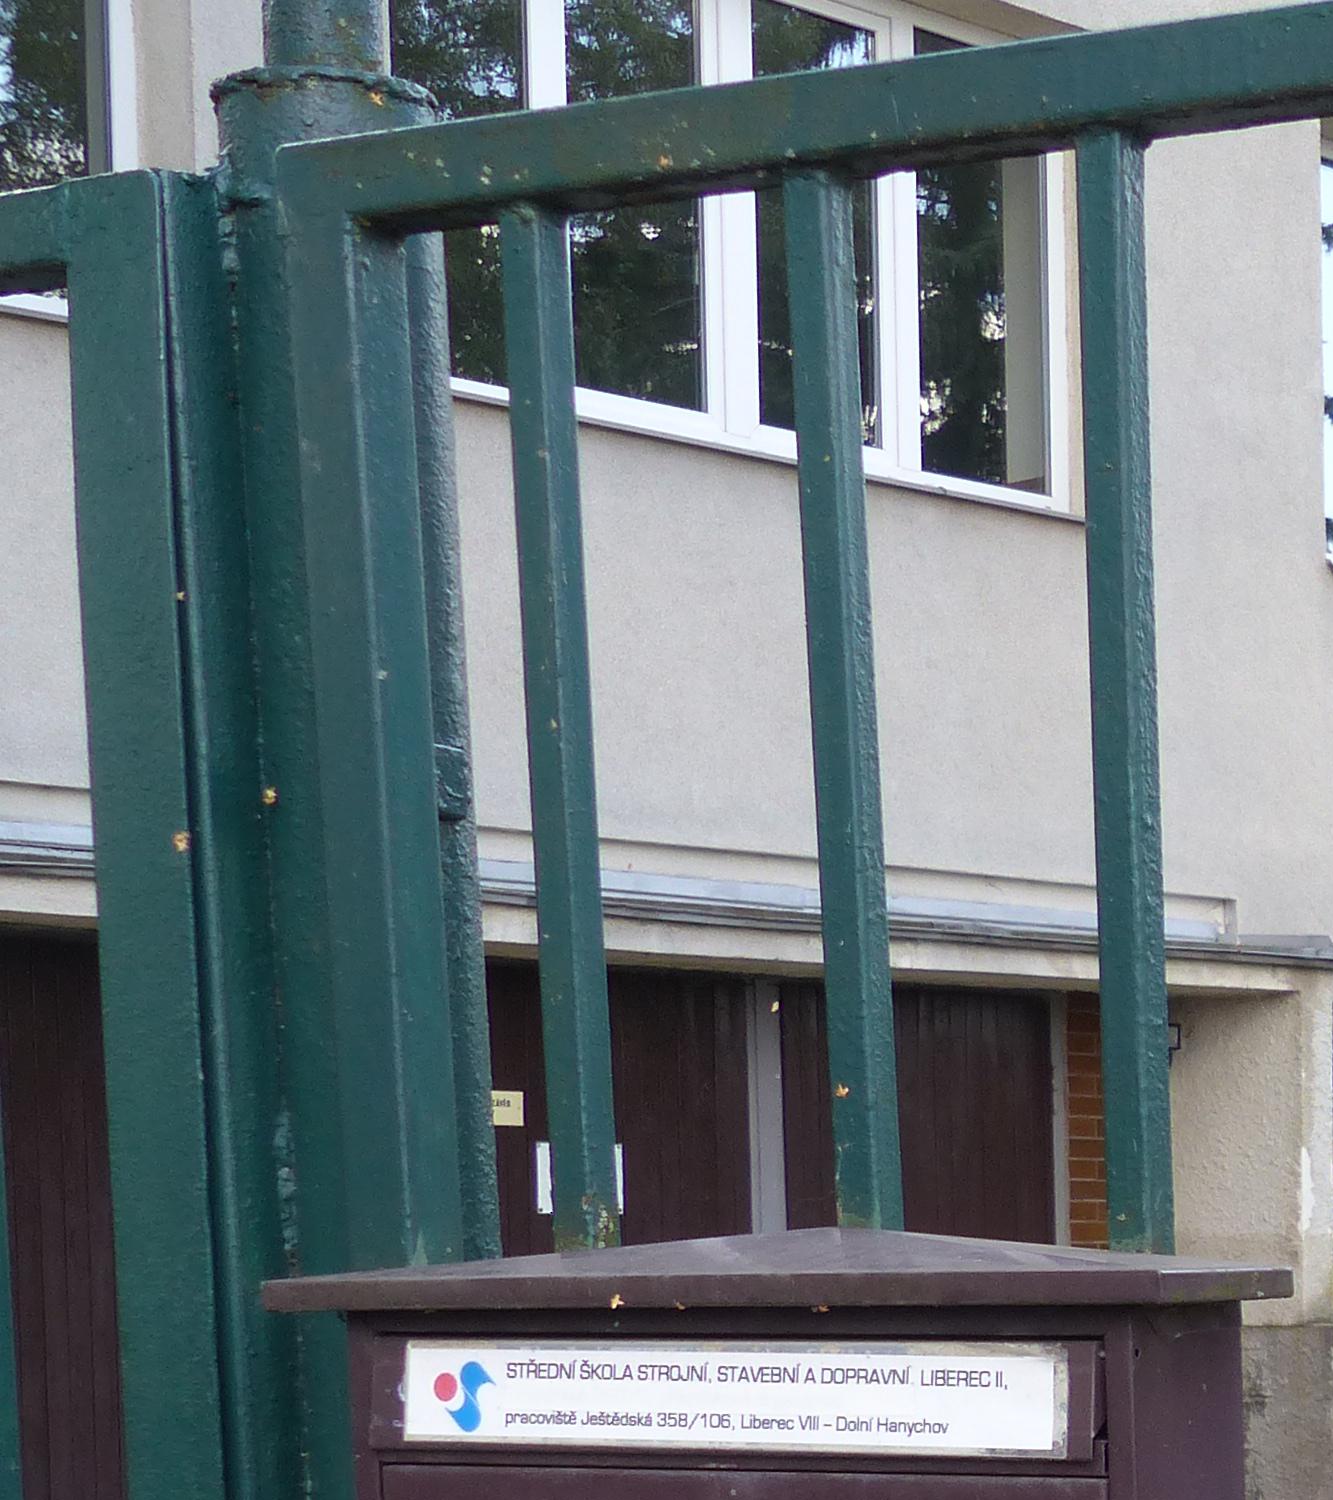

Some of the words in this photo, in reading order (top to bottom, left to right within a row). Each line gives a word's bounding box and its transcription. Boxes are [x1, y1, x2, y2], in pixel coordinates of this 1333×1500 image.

[507, 1359, 577, 1379] STŘEDNÍ
[580, 1360, 633, 1380] ŠKOLA
[638, 1362, 711, 1383] STROJNÍ,
[718, 1364, 800, 1383] STAVEBNÍ
[804, 1368, 816, 1383] A
[921, 1370, 990, 1387] LIBEREC
[996, 1371, 1007, 1389] II,
[506, 1411, 576, 1427] pracoviště
[581, 1412, 652, 1426] Ještědská
[657, 1413, 734, 1430] 358/106,
[741, 1415, 794, 1430] Liberec
[799, 1416, 819, 1430] VIII
[836, 1416, 871, 1431] Dolní
[877, 1418, 948, 1437] Hanychov
